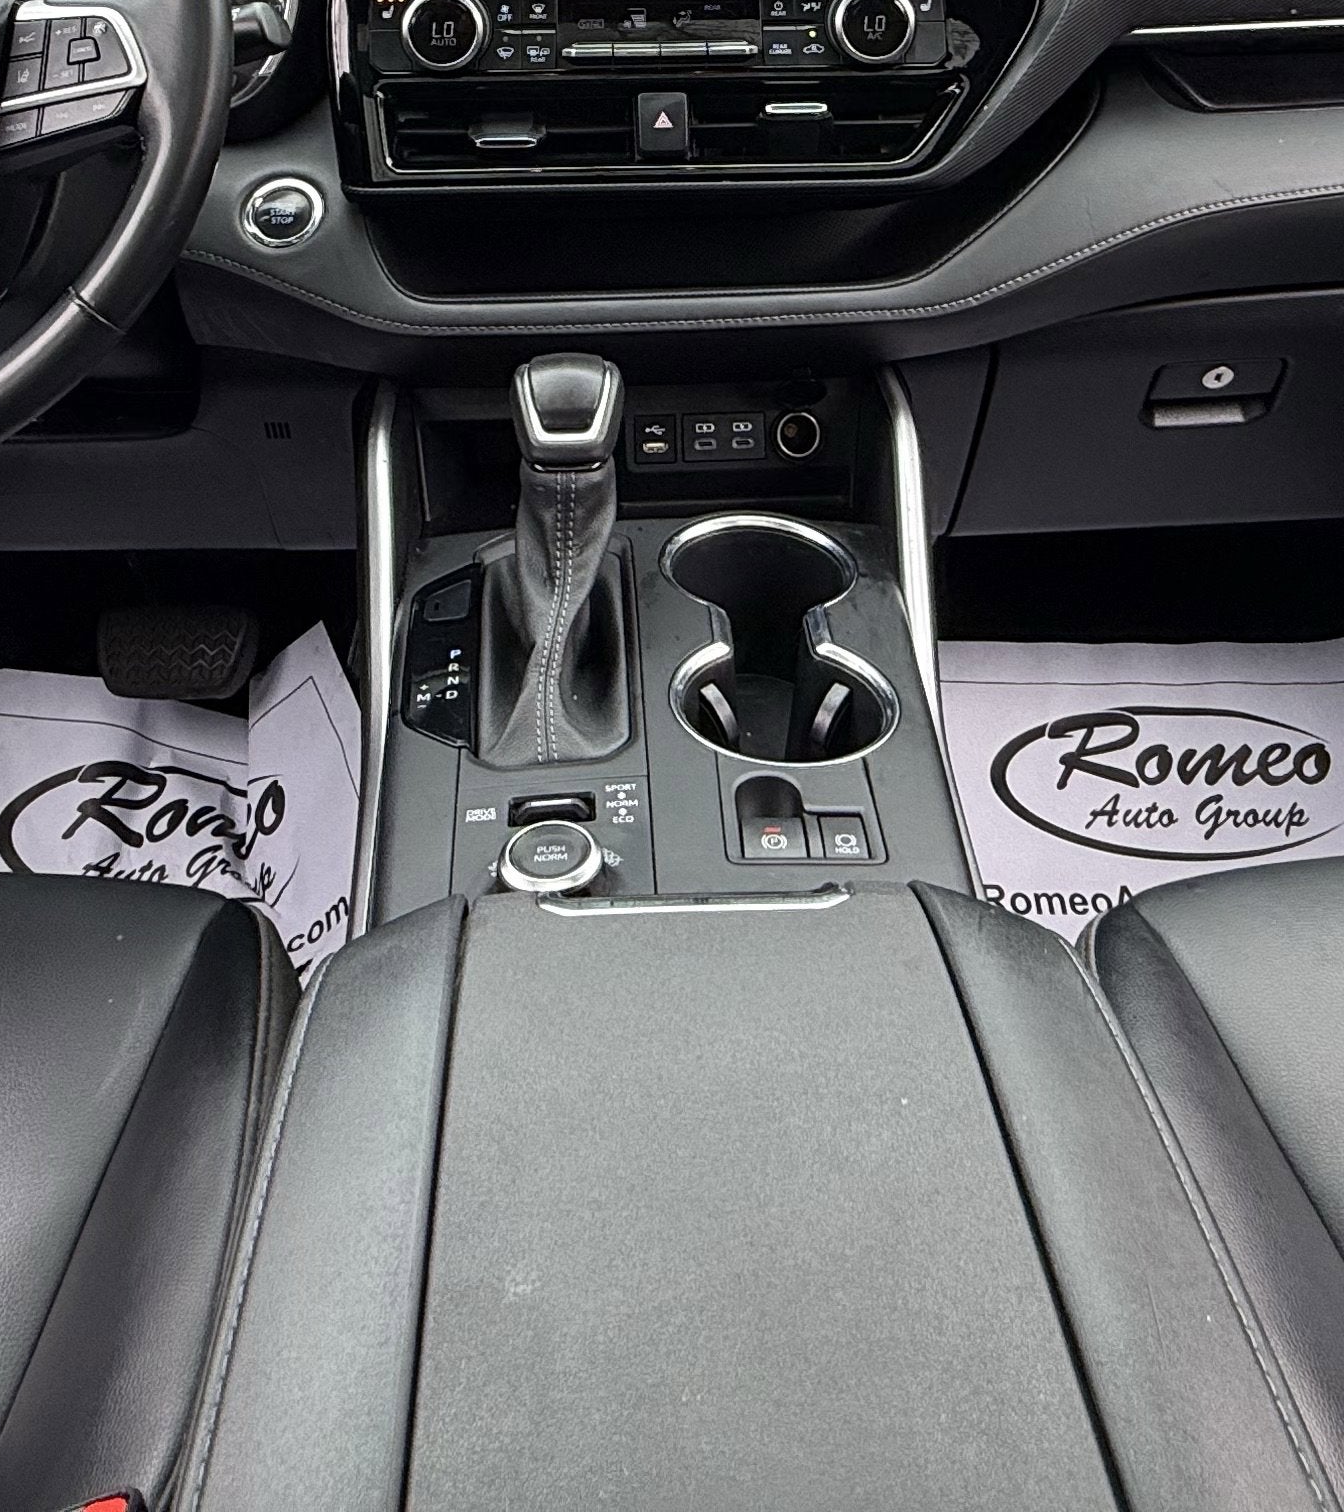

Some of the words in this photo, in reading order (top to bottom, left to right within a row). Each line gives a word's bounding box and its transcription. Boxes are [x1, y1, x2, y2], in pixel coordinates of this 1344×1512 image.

[497, 13, 513, 23] OFF
[863, 15, 886, 33] LO
[431, 21, 455, 39] LO
[430, 37, 457, 47] AUTO
[271, 216, 295, 225] STOP
[450, 648, 463, 660] P
[447, 662, 460, 673] R
[447, 675, 460, 686] N
[445, 689, 459, 700] D
[1048, 710, 1332, 791] Romeo
[605, 783, 637, 792] SPORT
[606, 799, 639, 809] NORM
[466, 807, 496, 816] DRIVE
[465, 814, 497, 823] MODE
[612, 815, 635, 824] ECO
[1084, 793, 1179, 831] Auto
[1194, 794, 1311, 841] Group
[536, 845, 566, 854] PUSH
[834, 846, 861, 854] HOLD
[533, 853, 568, 863] NORM
